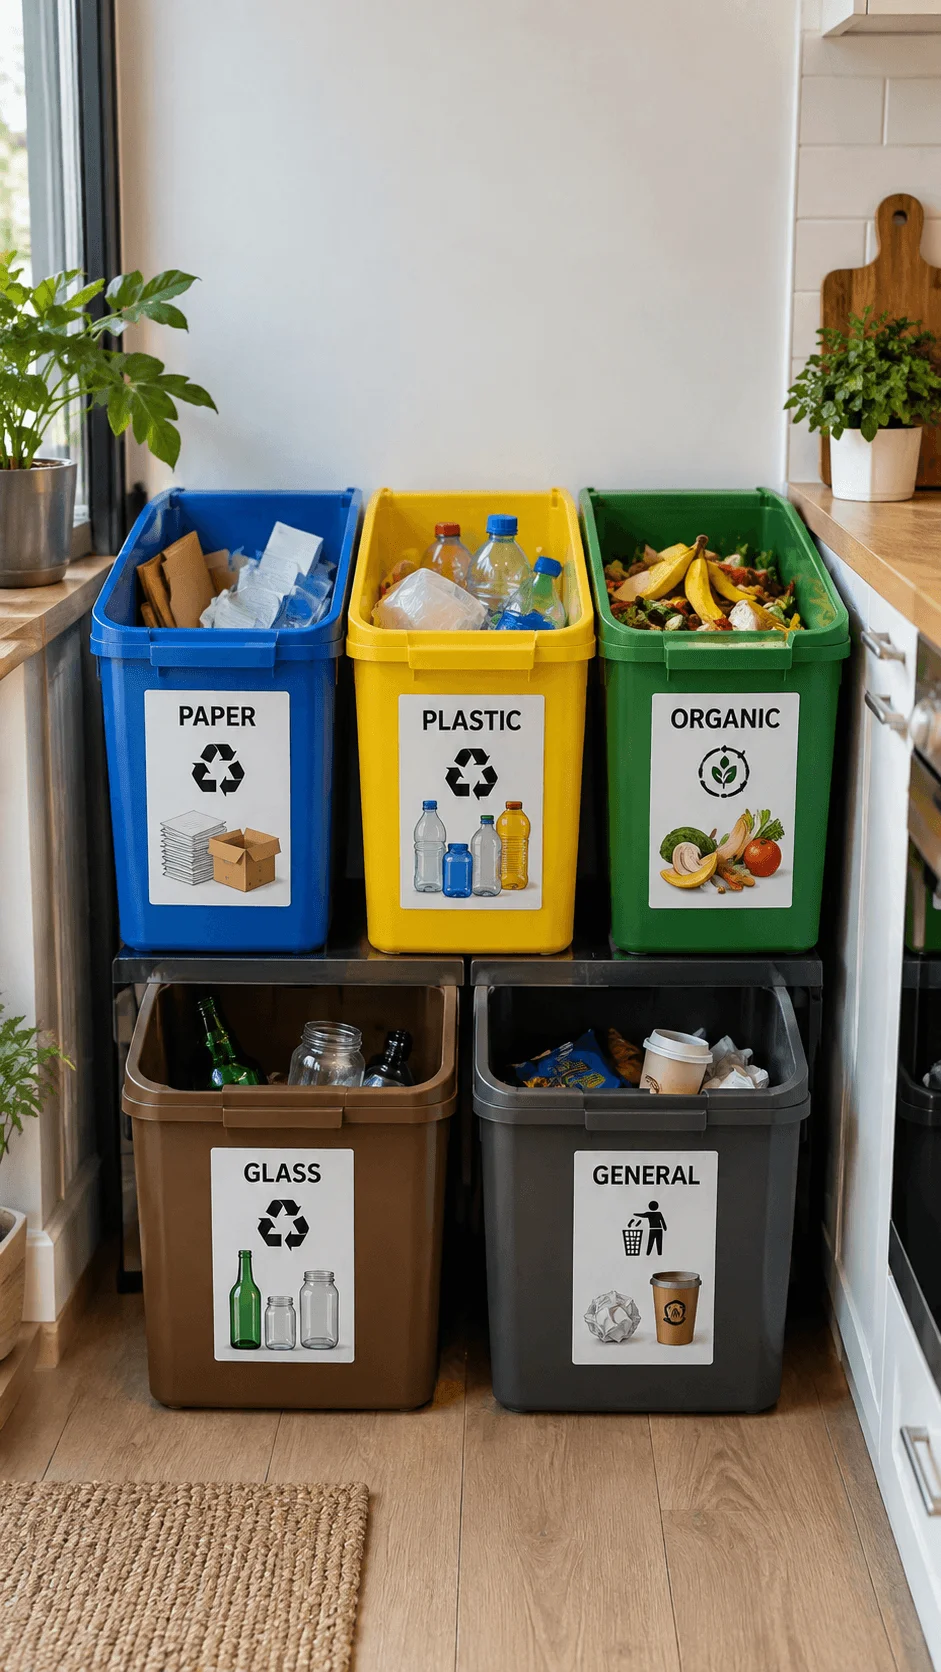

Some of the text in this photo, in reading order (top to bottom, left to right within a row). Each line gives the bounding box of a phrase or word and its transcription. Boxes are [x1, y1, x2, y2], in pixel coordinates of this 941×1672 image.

[180, 706, 256, 726] PAPER
[423, 710, 521, 731] PLASTIC
[671, 708, 780, 729] ORGANIC
[244, 1163, 321, 1183] GLASS
[593, 1165, 700, 1185] GENERAL
